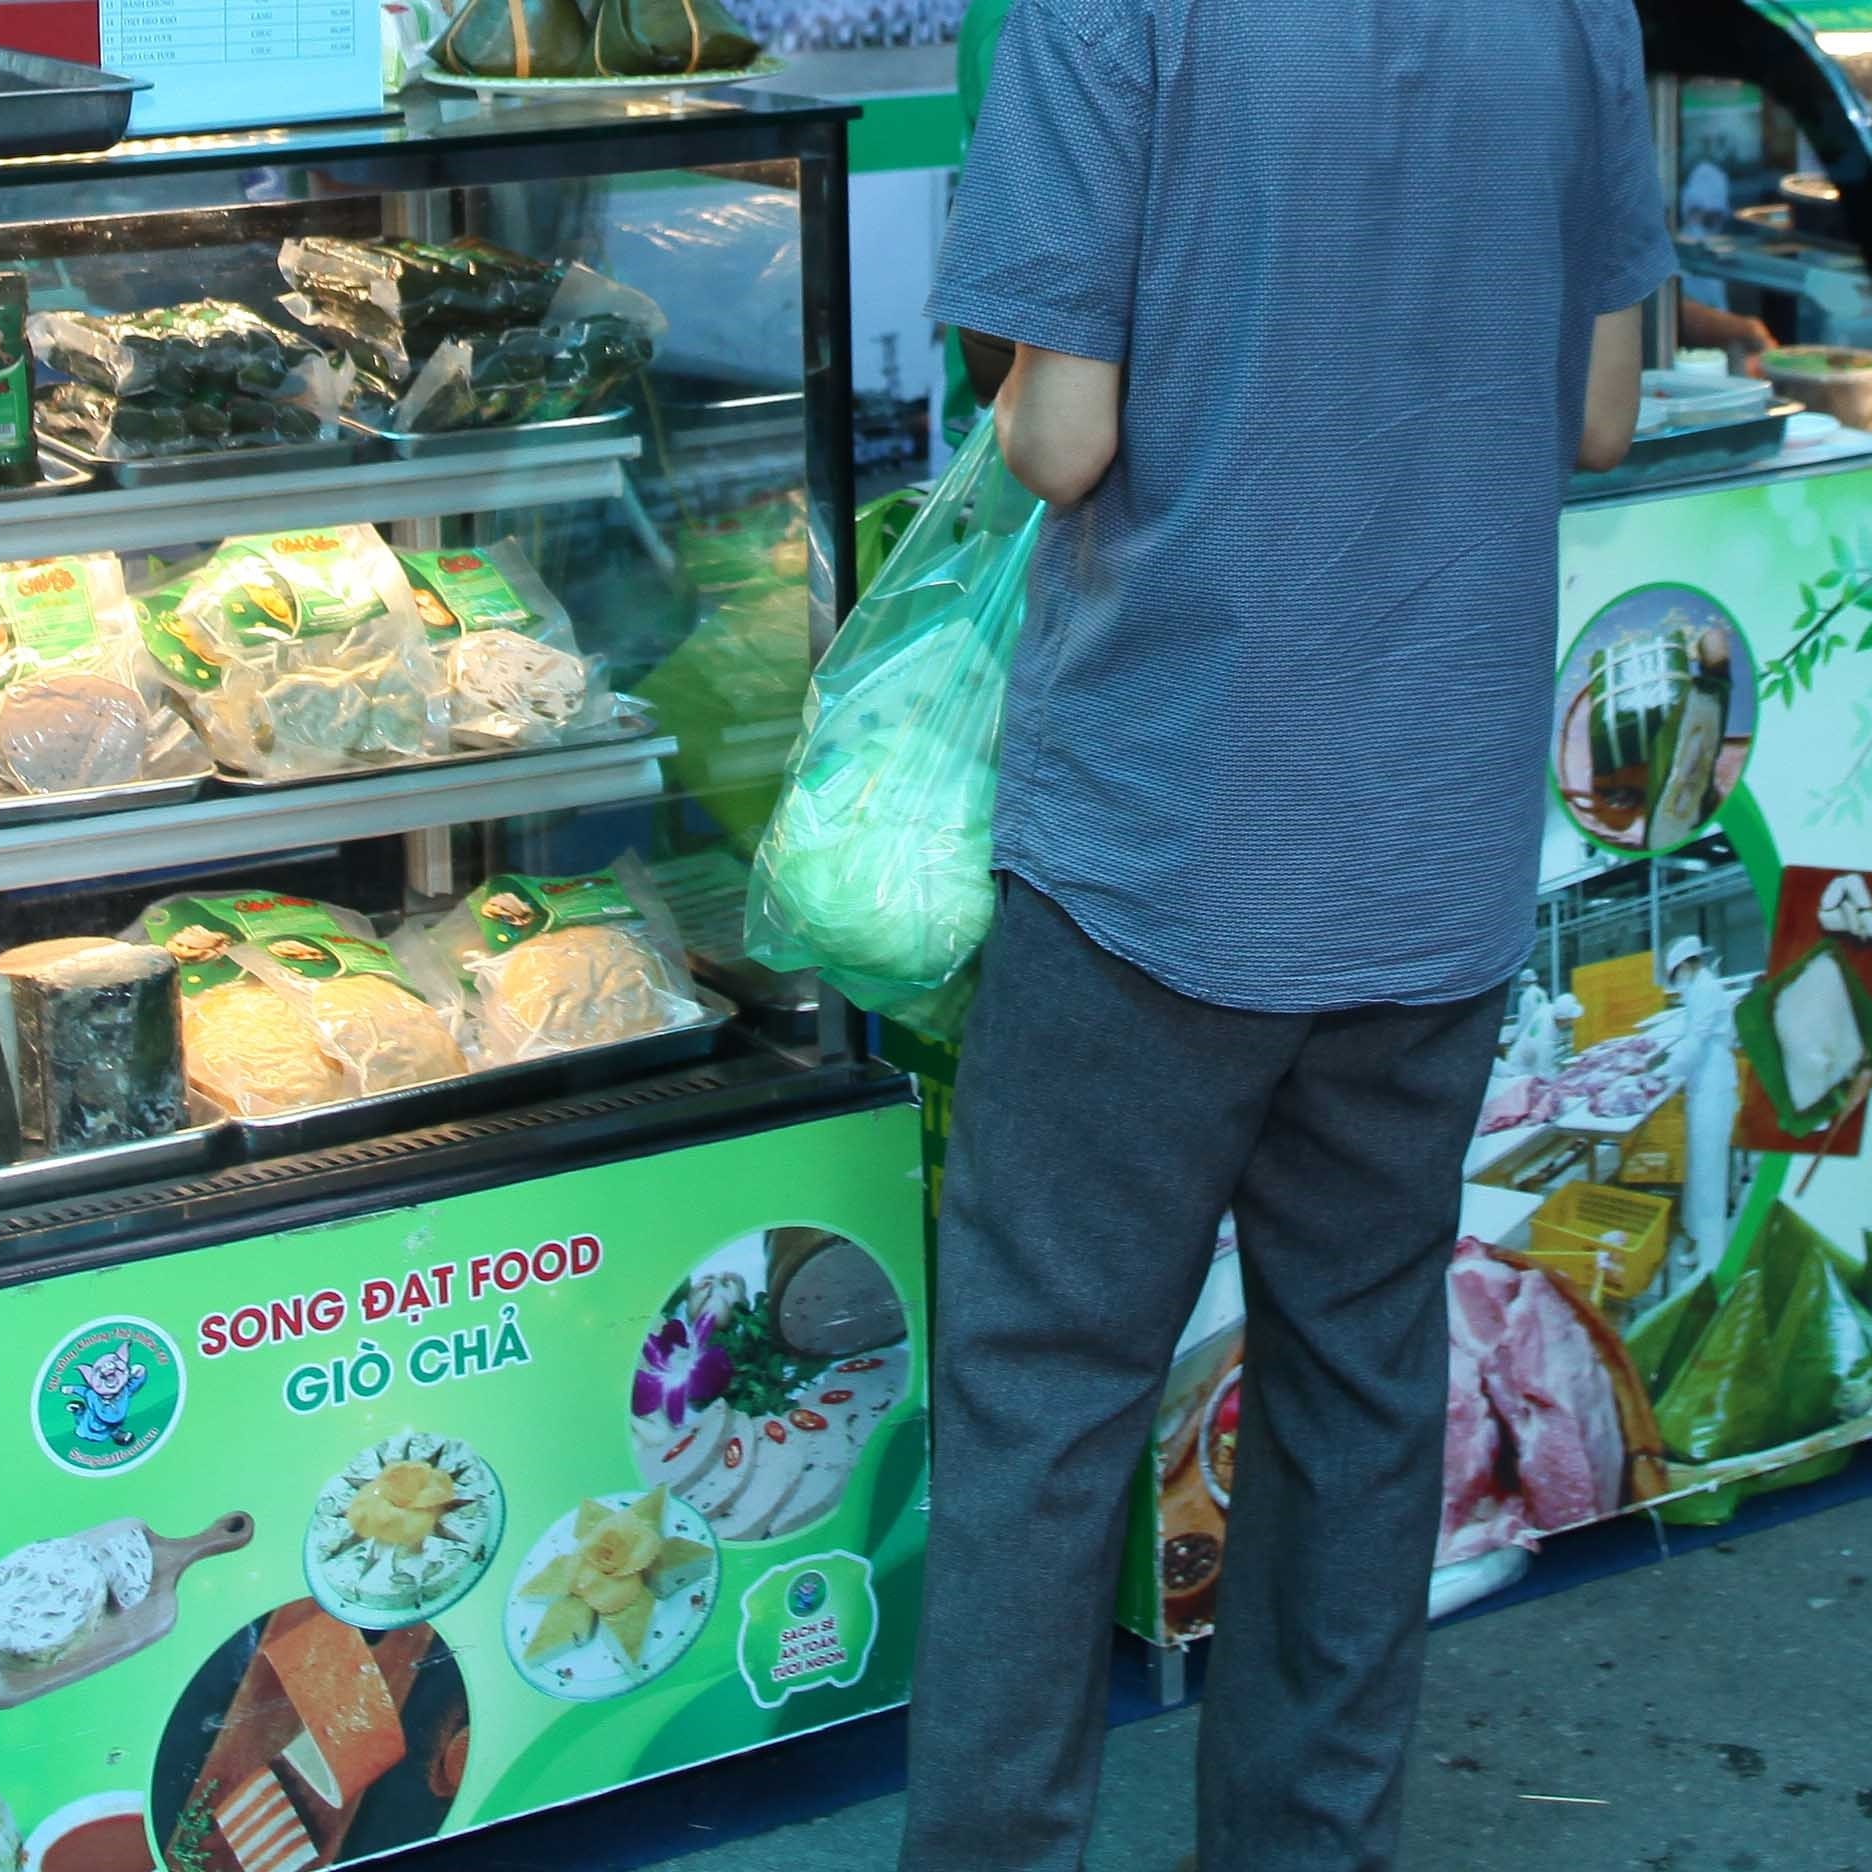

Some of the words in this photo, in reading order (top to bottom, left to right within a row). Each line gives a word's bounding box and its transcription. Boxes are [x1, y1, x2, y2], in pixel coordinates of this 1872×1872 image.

[201, 1290, 344, 1357] SONG
[361, 1266, 453, 1324] ĐẠT
[470, 1235, 601, 1298] FOOD
[284, 1341, 391, 1415] GIÒ
[409, 1306, 529, 1385] CHẢ
